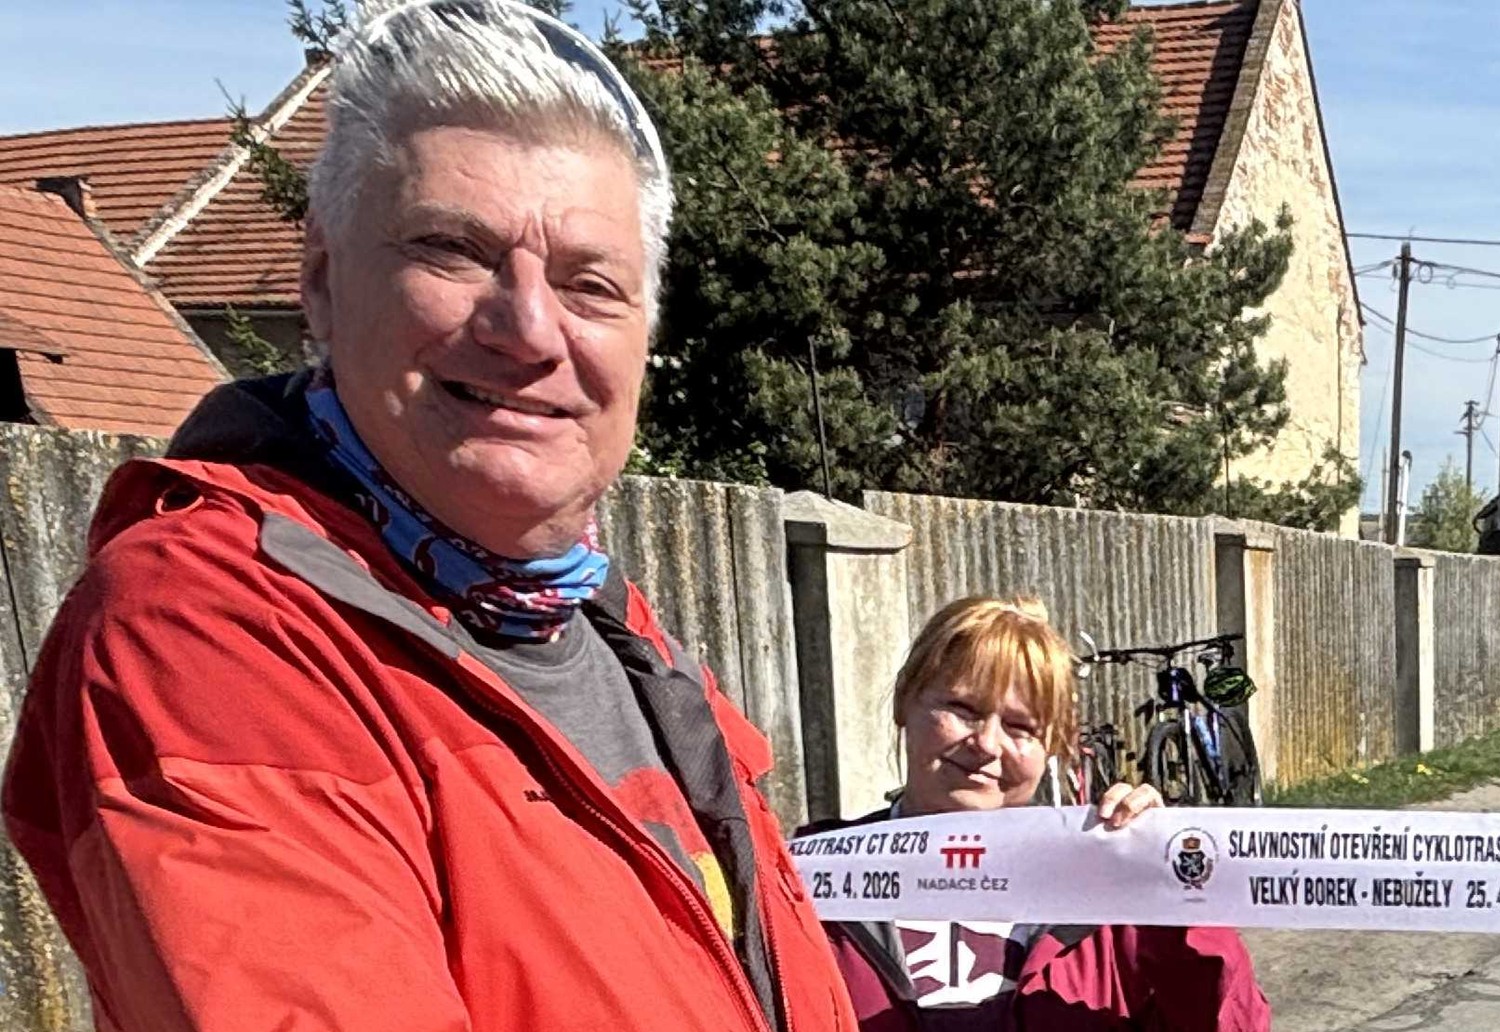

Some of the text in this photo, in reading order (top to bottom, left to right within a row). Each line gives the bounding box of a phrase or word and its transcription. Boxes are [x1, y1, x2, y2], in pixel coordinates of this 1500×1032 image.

[788, 830, 930, 857] KLOTRASY CT 8278
[1228, 823, 1327, 860] SLAVNOSTNÍ
[1330, 825, 1410, 861] OTEVŘENÍ
[813, 870, 900, 900] 25. 4. 2026
[917, 875, 1009, 892] NADACE ČEZ
[1249, 868, 1301, 906] VELKÝ
[1305, 876, 1358, 907] BOREK
[1371, 871, 1453, 909] NEBUŽELY
[1466, 879, 1492, 909] 25.
